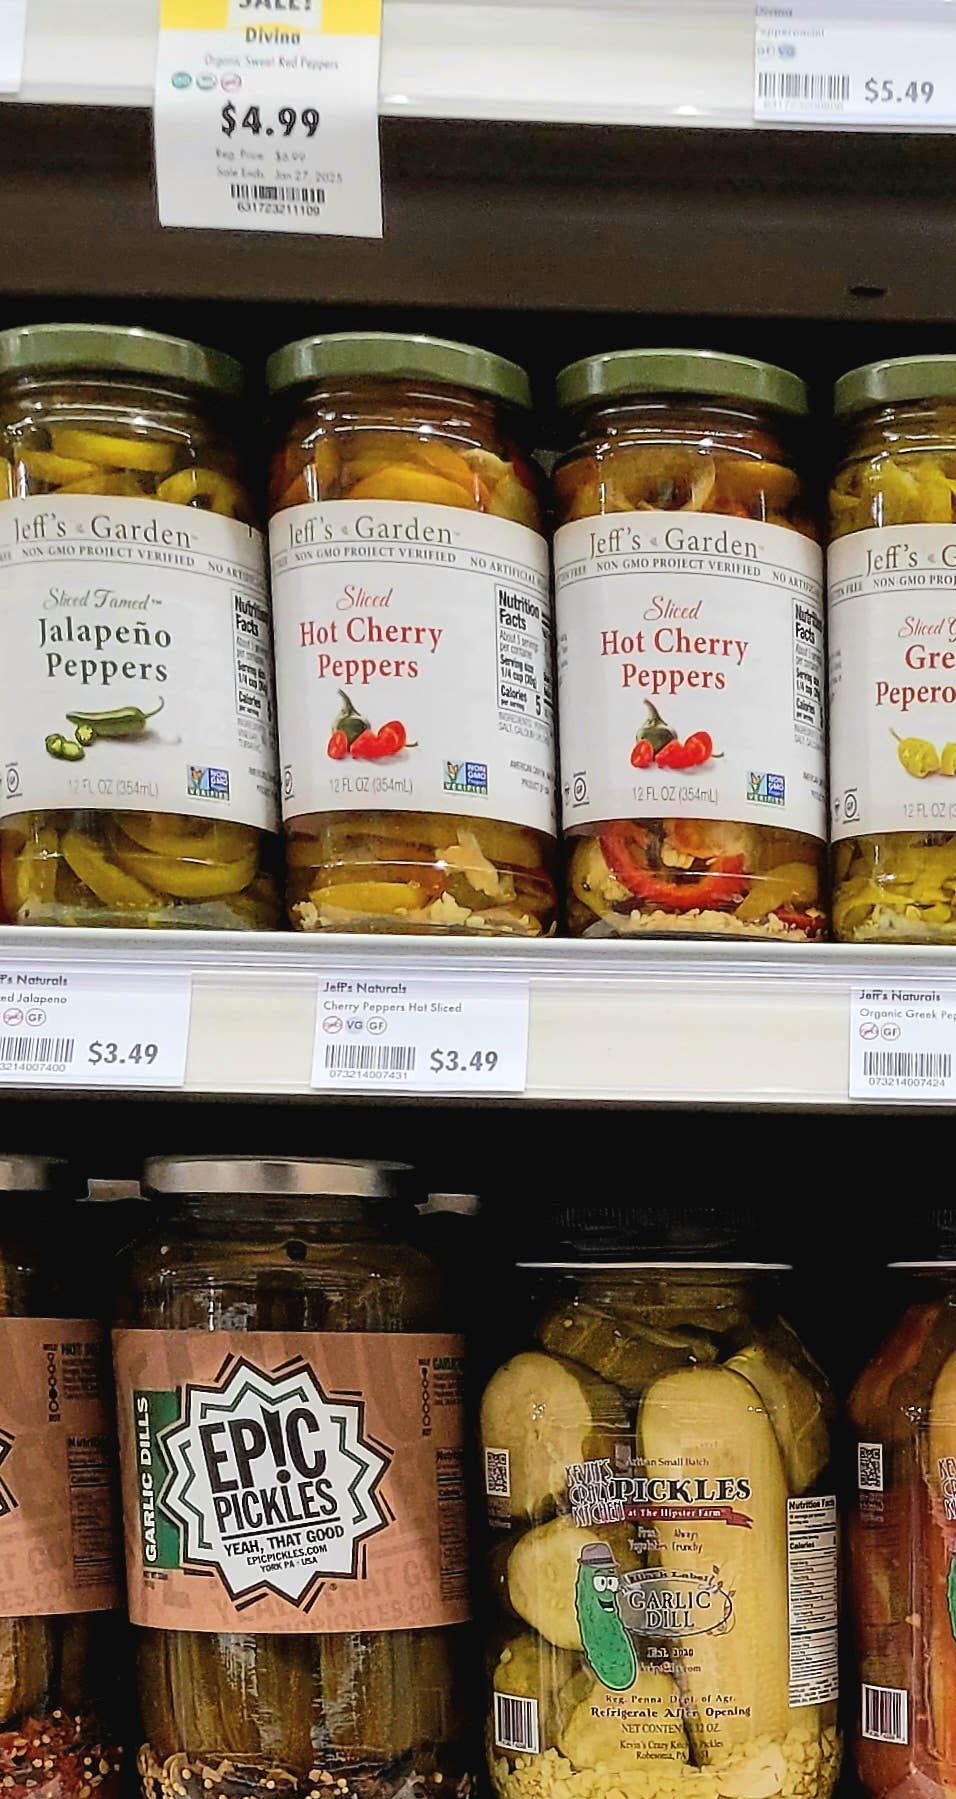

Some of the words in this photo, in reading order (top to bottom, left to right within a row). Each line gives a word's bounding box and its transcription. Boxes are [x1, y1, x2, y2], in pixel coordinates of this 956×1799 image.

[865, 77, 934, 103] $5.49
[222, 101, 320, 137] $4.99
[38, 616, 171, 650] Jalapeño
[300, 619, 338, 647] Hot
[346, 618, 444, 651] Cherry
[601, 629, 644, 656] Hot
[654, 628, 749, 666] Cherry
[45, 652, 168, 685] Peppers
[318, 654, 418, 684] Peppers
[621, 663, 726, 694] Peppers
[17, 975, 68, 986] Naturals
[323, 1002, 358, 1013] Cherry
[363, 1003, 404, 1013] Peppers
[409, 1003, 427, 1012] Hot
[431, 1003, 462, 1013] Sliced
[88, 1041, 158, 1065] $3.49
[431, 1048, 498, 1073] $3.49
[136, 1397, 151, 1466] DILLS
[611, 1476, 751, 1503] PICKLES
[136, 1473, 156, 1562] GARLIC
[213, 1479, 337, 1532] PICKLES
[223, 1538, 264, 1558] YEAH,
[268, 1535, 301, 1550] THAT
[306, 1525, 344, 1542] GOOD
[629, 1592, 711, 1609] GARLIC
[646, 1610, 694, 1628] DILL
